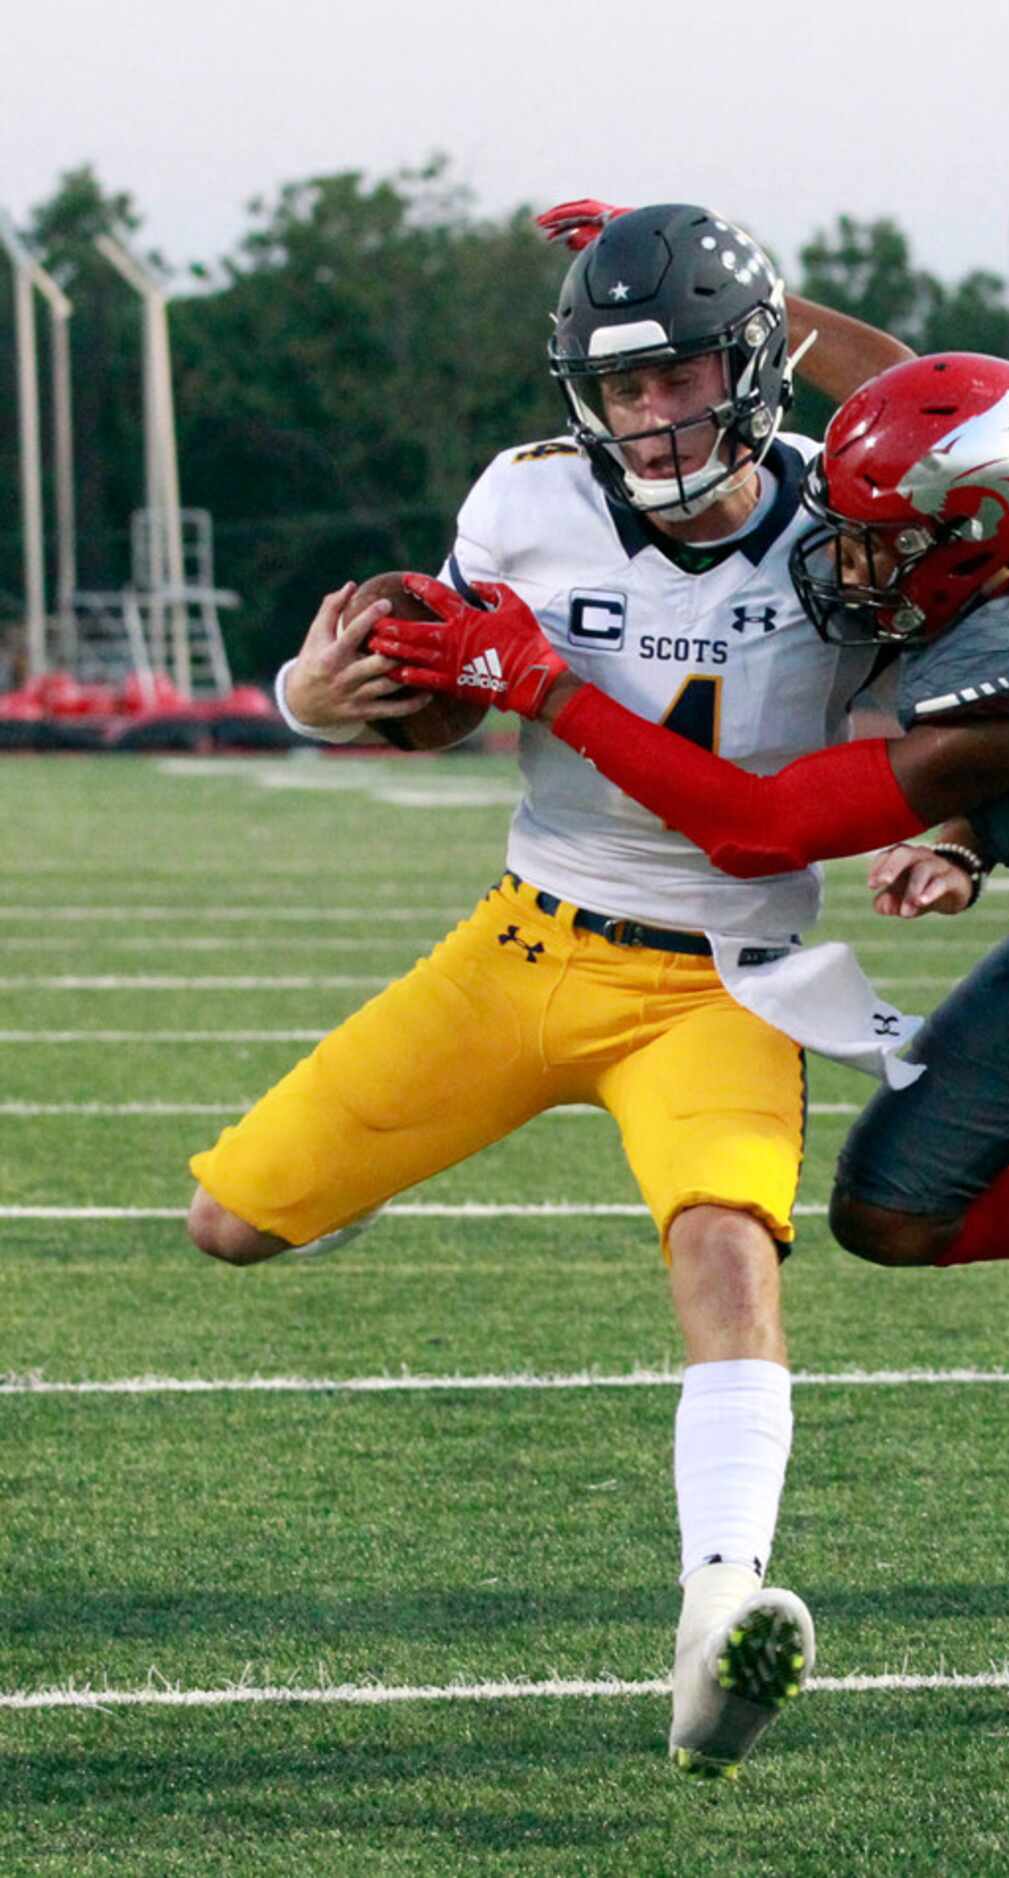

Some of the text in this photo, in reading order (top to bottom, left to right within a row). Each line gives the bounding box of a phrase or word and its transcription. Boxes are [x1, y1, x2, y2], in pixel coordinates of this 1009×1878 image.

[570, 598, 624, 640] C
[639, 635, 728, 664] SCOTS
[457, 674, 508, 692] adidas
